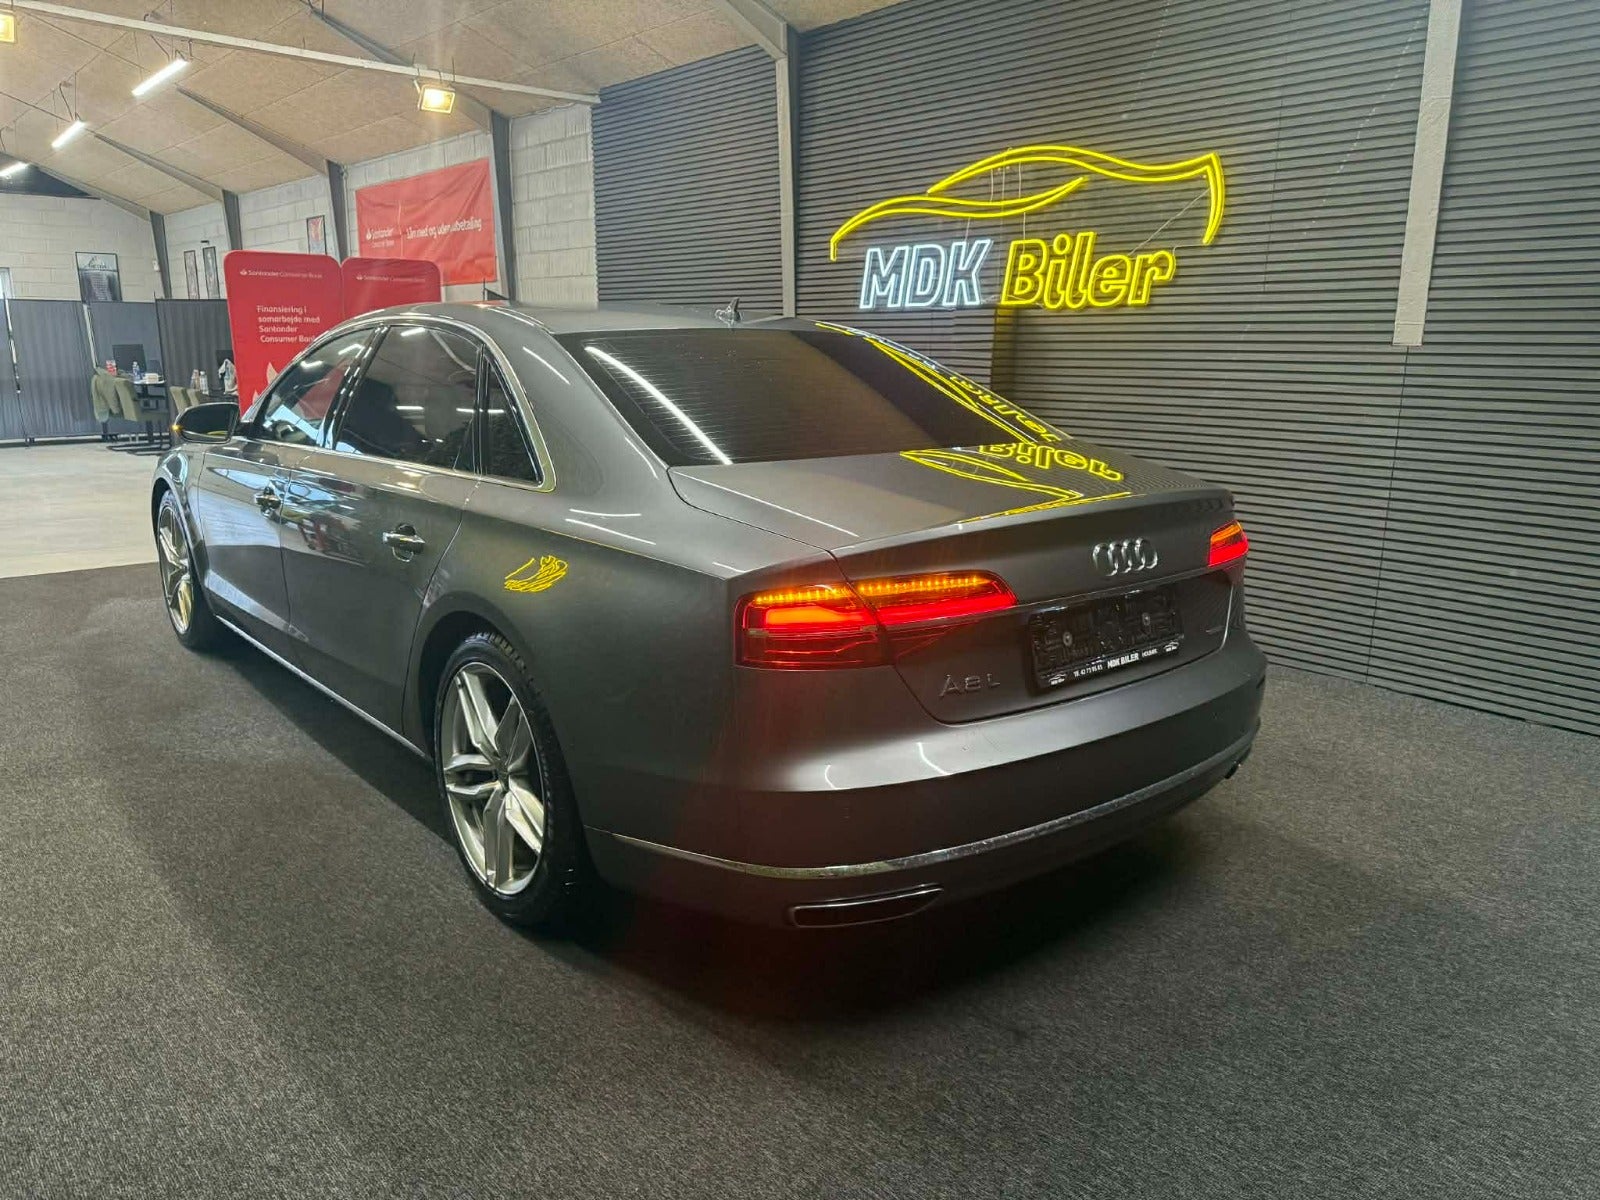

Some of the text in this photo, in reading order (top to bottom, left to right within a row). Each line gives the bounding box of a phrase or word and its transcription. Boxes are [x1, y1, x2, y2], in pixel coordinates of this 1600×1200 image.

[248, 269, 279, 277] Santander
[858, 231, 1178, 311] MDK Biler
[256, 305, 303, 315] Finansiering
[258, 315, 302, 324] samarbejde
[258, 325, 298, 333] Santander
[260, 335, 298, 343] Consumer
[1120, 652, 1140, 666] BILER
